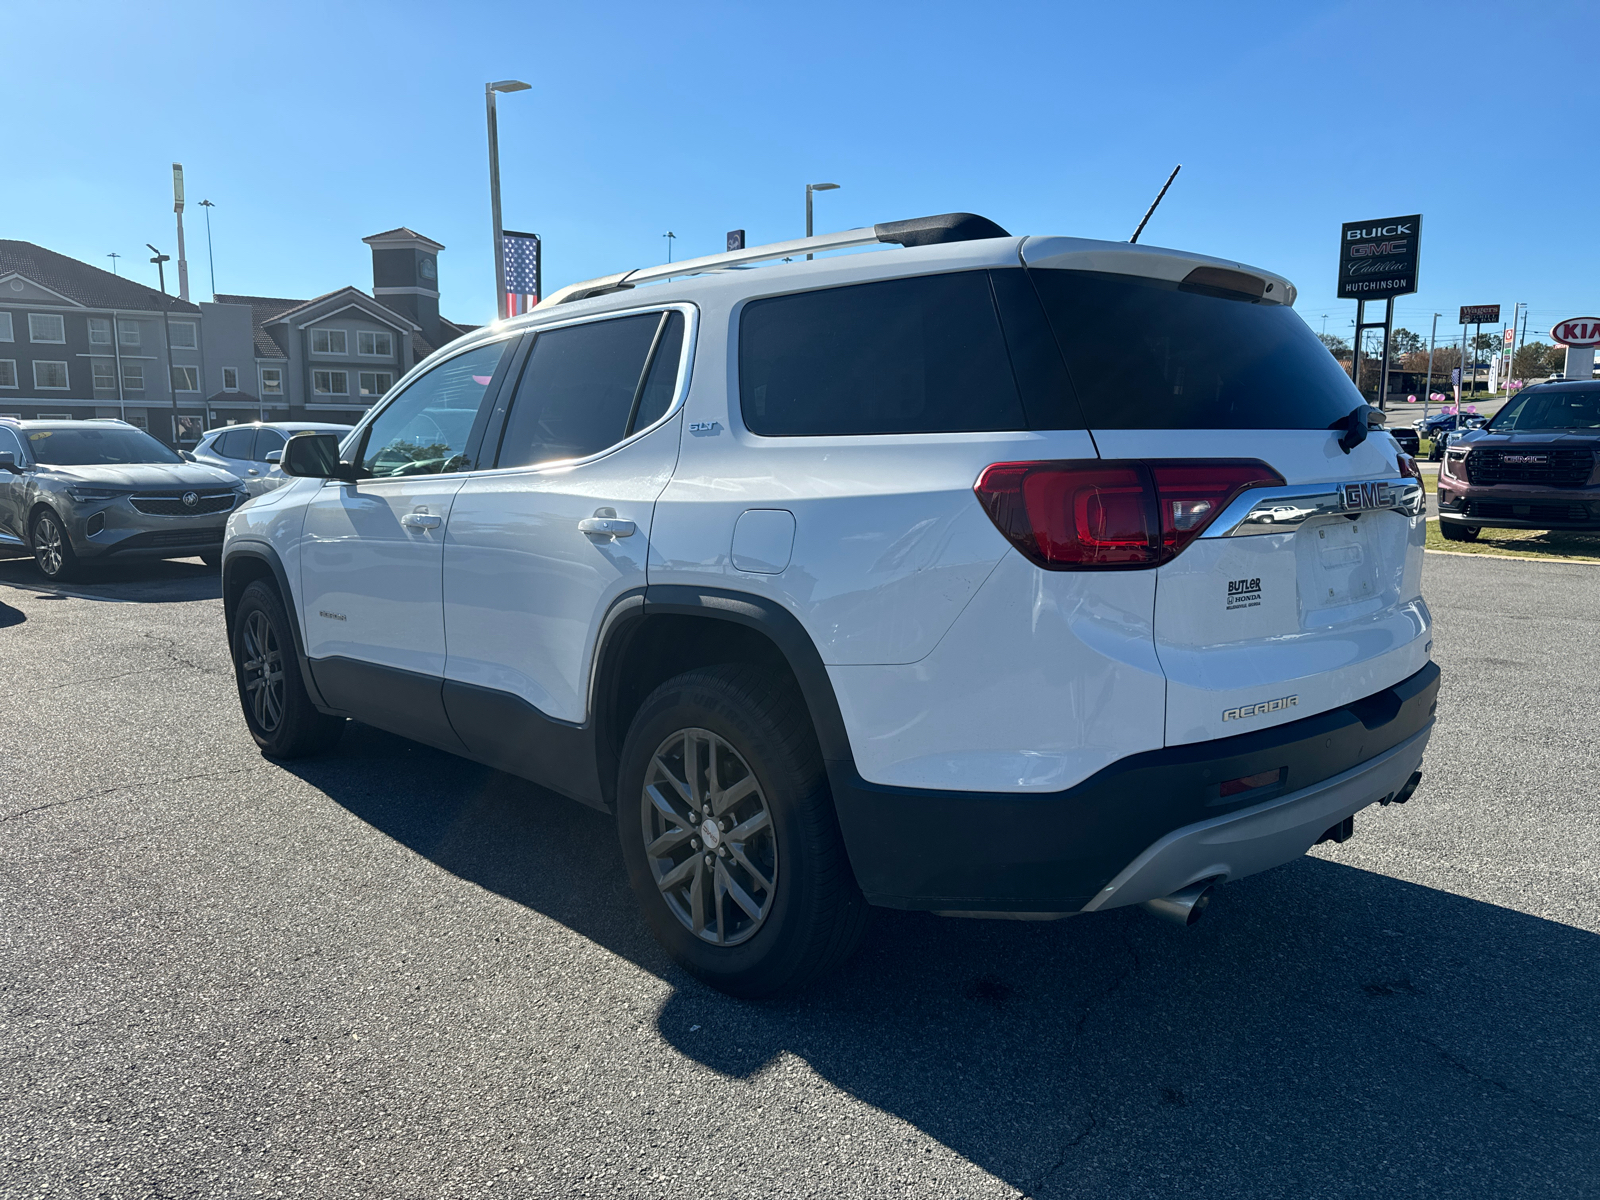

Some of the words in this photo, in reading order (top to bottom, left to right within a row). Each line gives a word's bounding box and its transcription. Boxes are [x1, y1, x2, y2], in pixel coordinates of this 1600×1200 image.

[1347, 224, 1411, 240] BUICK
[1350, 240, 1407, 257] GMC
[1348, 259, 1407, 276] Cadillac
[1346, 279, 1407, 292] HUTCHINSON
[1463, 306, 1499, 315] Wagers
[688, 421, 719, 431] SLT
[1503, 455, 1548, 464] GMC
[1343, 482, 1392, 510] GMC
[1234, 594, 1262, 603] HONDA
[1222, 694, 1300, 722] ACADIA
